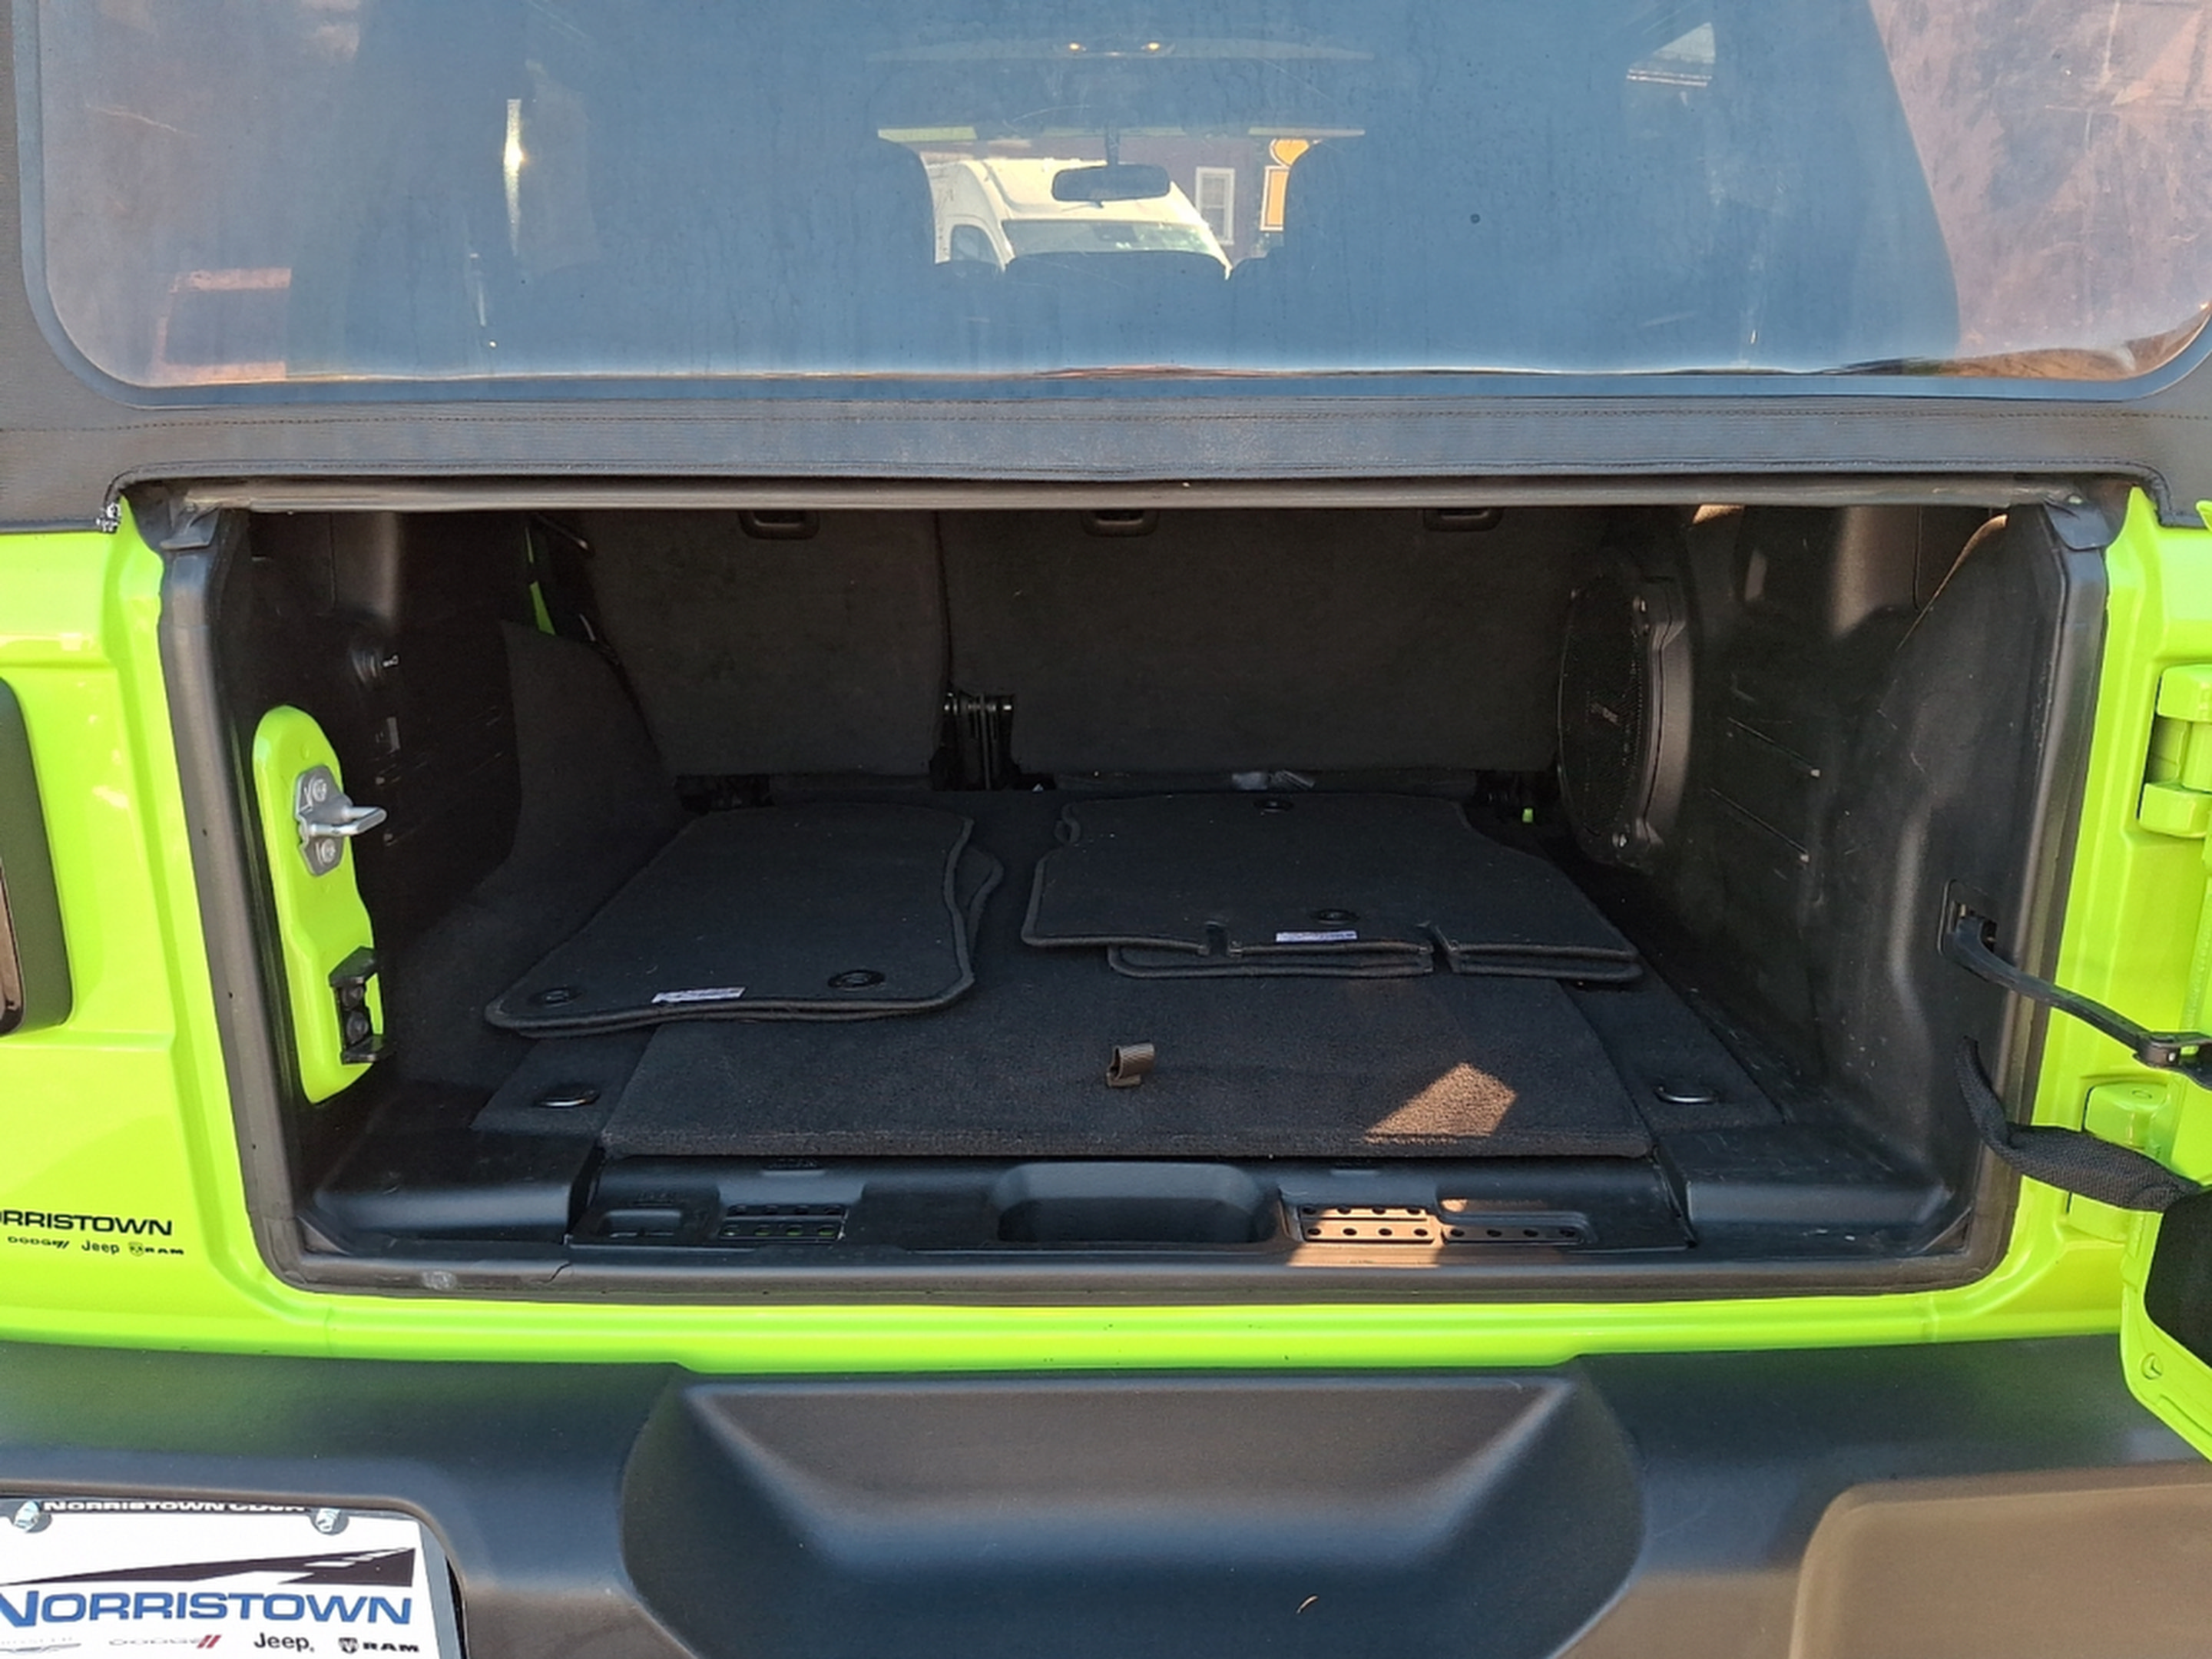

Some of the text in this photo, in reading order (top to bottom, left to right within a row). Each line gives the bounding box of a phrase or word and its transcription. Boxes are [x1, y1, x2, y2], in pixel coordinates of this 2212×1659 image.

[0, 1210, 173, 1236] RRISTOWN
[81, 1240, 120, 1254] Jeep
[145, 1246, 184, 1255] RAM
[43, 1501, 224, 1512] NORRISTOWN
[0, 1590, 412, 1628] NORRISTOWN
[363, 1641, 419, 1652] RAM
